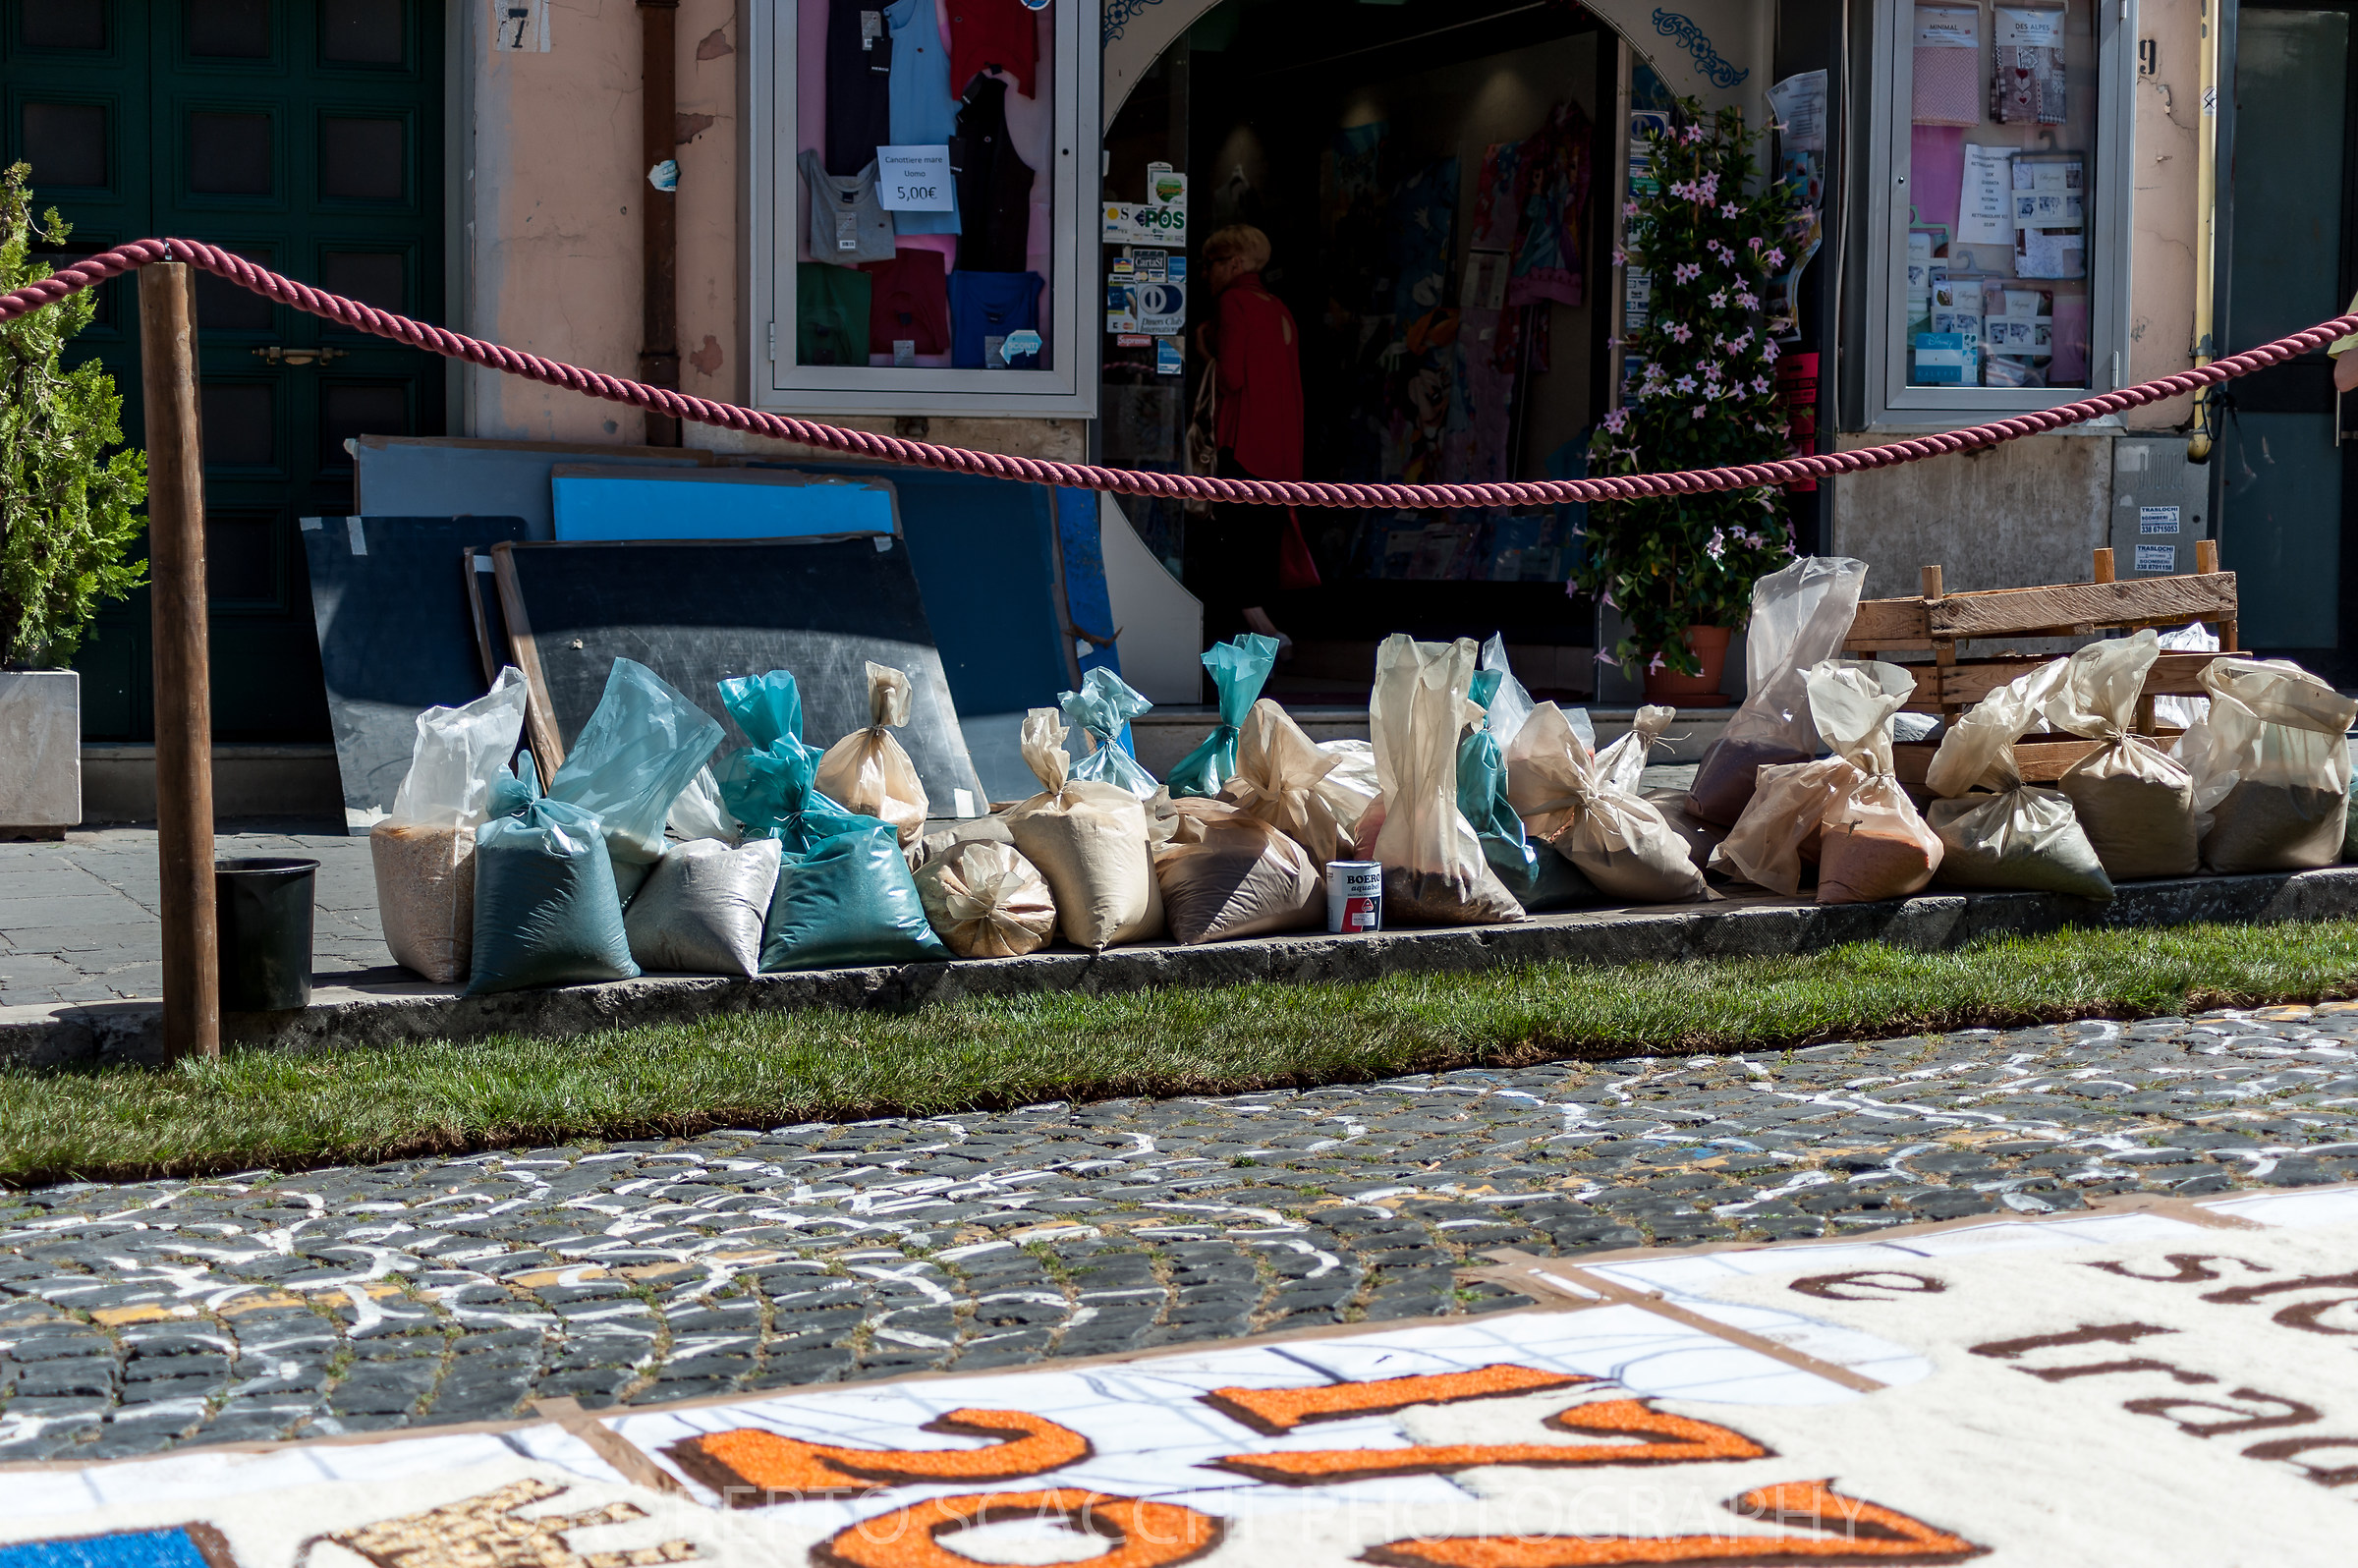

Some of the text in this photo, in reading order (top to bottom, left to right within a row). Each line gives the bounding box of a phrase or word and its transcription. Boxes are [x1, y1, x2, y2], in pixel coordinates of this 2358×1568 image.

[508, 8, 529, 48] 7
[2139, 38, 2157, 75] 9
[897, 186, 937, 201] 5,00€
[1118, 336, 1151, 346] Supreme
[1347, 873, 1380, 884] BOERO
